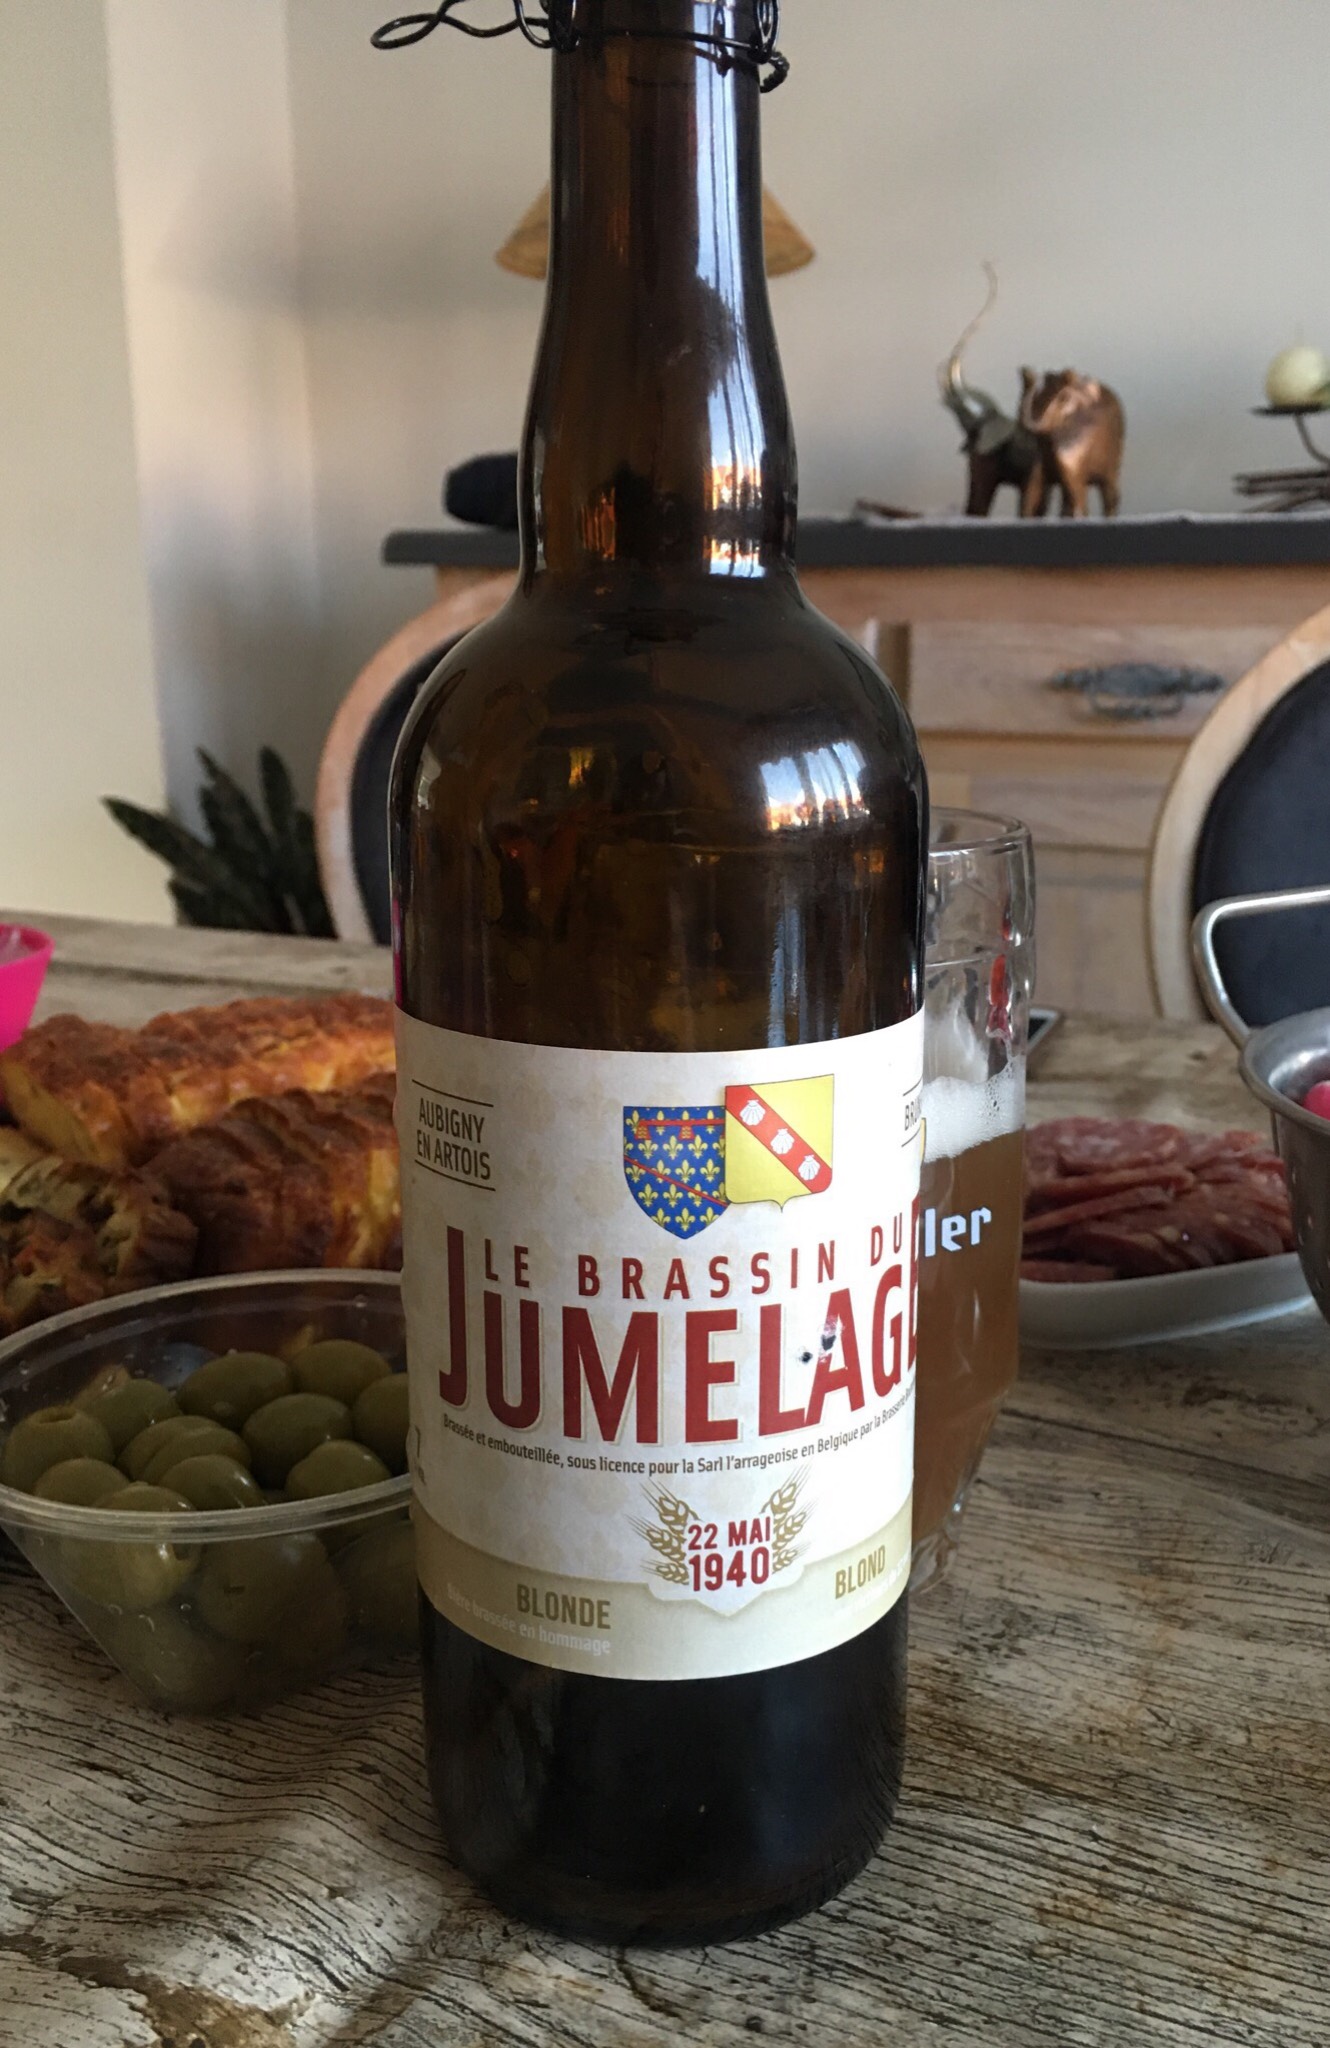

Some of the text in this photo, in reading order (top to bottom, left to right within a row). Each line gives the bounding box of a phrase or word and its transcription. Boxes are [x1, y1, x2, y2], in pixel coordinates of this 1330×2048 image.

[419, 1097, 485, 1144] AUBIGNY
[416, 1129, 491, 1180] EN ARTOIS
[484, 1213, 902, 1301] LE BRASSIN DU
[443, 1412, 474, 1442] Brassée
[476, 1432, 486, 1447] et
[487, 1437, 564, 1469] embouteillée,
[567, 1455, 596, 1470] sous
[599, 1456, 645, 1474] licence
[649, 1462, 679, 1477] pour
[682, 1457, 694, 1473] la
[698, 1456, 723, 1473] Sarl
[801, 1445, 815, 1459] en
[818, 1429, 859, 1454] Belgique
[860, 1419, 873, 1440] par
[688, 1516, 771, 1551] 22 MAI
[688, 1546, 770, 1591] 1940
[835, 1545, 886, 1600] BLOND
[516, 1583, 611, 1630] BLONDE
[519, 1622, 535, 1639] en
[539, 1625, 611, 1657] hommage
